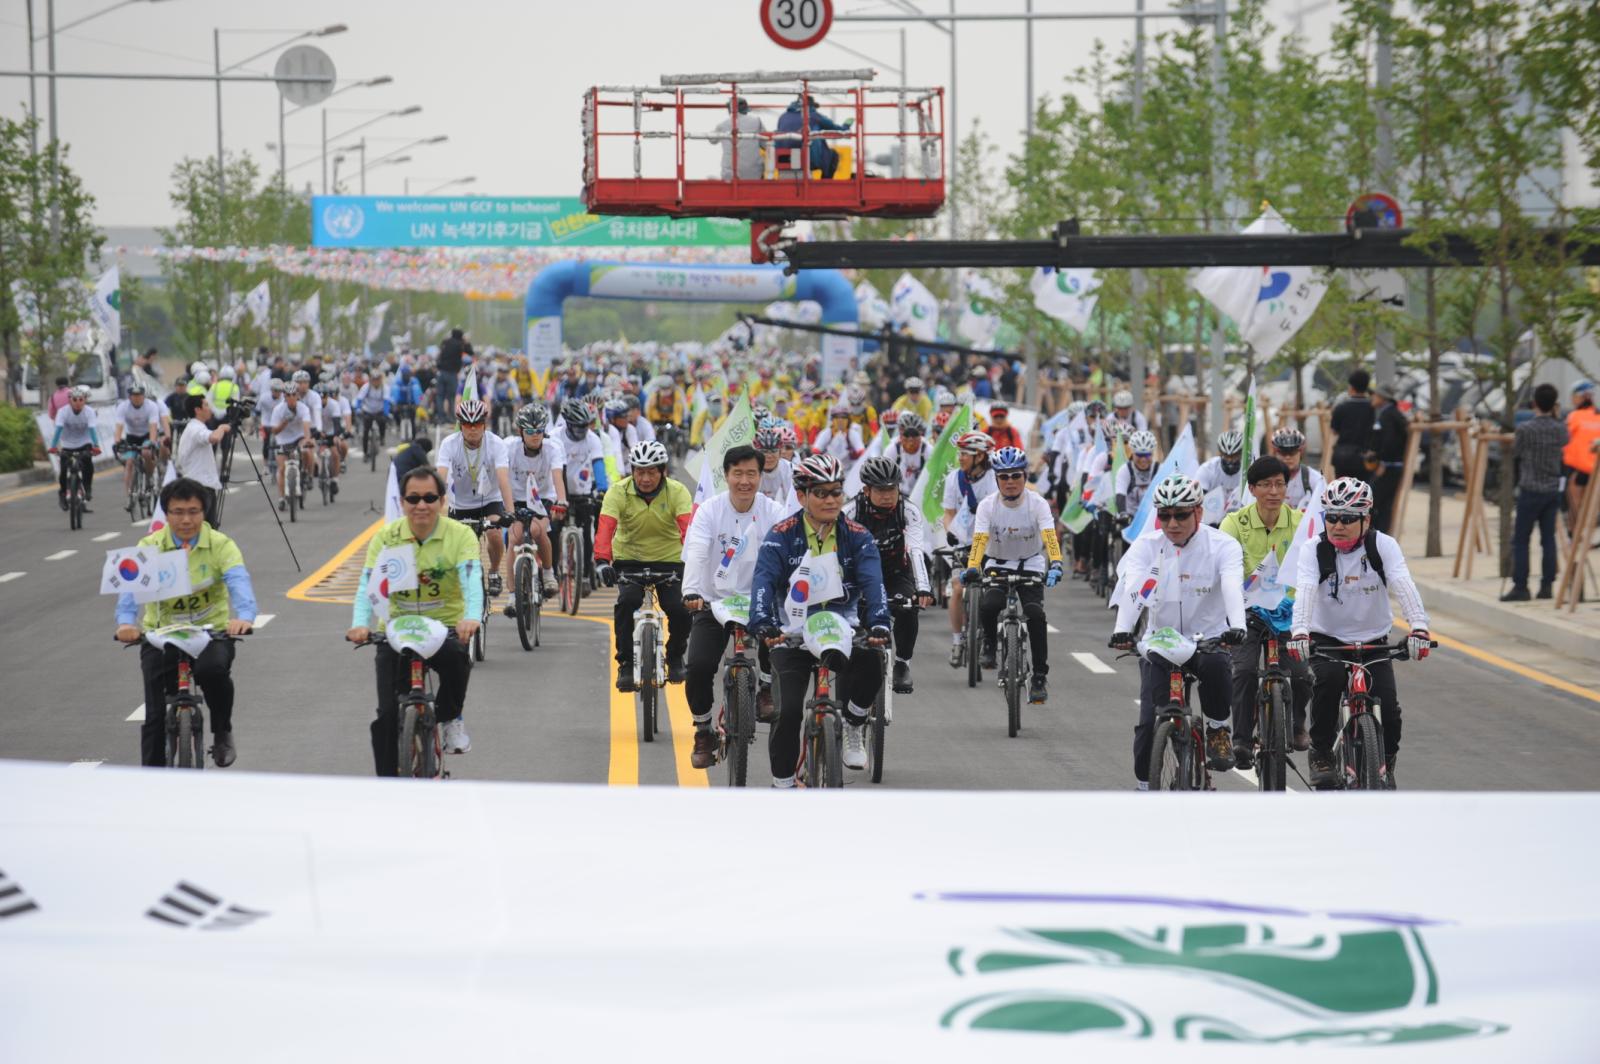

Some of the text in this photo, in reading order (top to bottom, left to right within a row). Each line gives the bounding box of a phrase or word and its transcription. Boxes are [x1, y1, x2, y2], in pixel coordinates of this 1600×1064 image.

[777, 0, 818, 28] 30
[376, 201, 561, 213] We welcome UN GCF to Incheon!
[411, 222, 436, 238] UN
[442, 221, 542, 240] 녹색기후기금
[608, 221, 698, 240] 유치합시다!
[173, 591, 209, 610] 421
[757, 587, 766, 602] Tour
